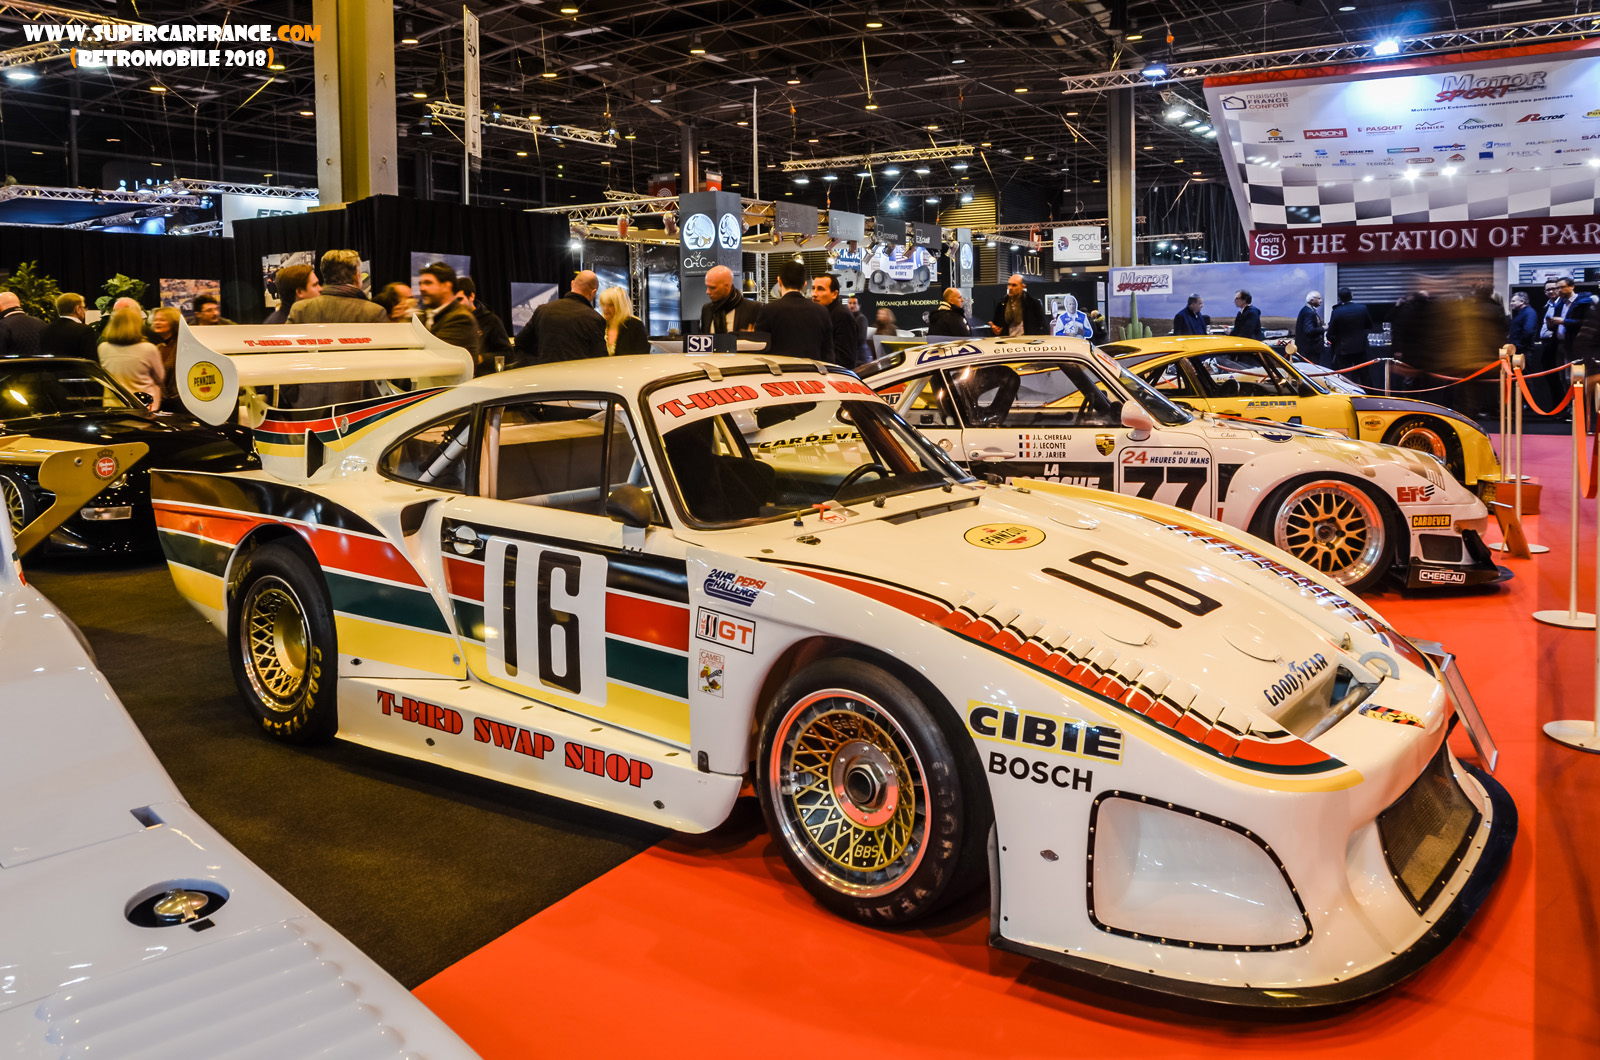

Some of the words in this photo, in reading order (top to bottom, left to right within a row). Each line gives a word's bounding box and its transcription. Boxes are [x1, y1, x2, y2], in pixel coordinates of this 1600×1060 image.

[1441, 70, 1547, 93] MOTOR
[1246, 92, 1288, 100] maisons
[1435, 84, 1512, 103] SPORT
[1249, 102, 1289, 110] CONFORT
[1458, 122, 1503, 131] Champeau
[1306, 130, 1344, 138] RABONI
[1071, 232, 1096, 243] sport
[1293, 233, 1348, 255] THE
[1358, 227, 1478, 254] STATION
[1488, 225, 1529, 248] OF
[1261, 244, 1279, 257] 66
[1016, 255, 1042, 276] PAUL
[1120, 271, 1169, 285] MOTOR
[1117, 281, 1153, 293] SPORT
[243, 339, 293, 347] T-BIRD
[296, 338, 334, 346] SWAP
[338, 337, 372, 345] SHOP
[689, 335, 712, 352] SP
[994, 345, 1067, 355] electropoli
[194, 374, 216, 387] PENNZOIL
[657, 384, 760, 419] T-BIRD
[760, 380, 826, 398] SWAP
[1044, 433, 1072, 441] CHEREAU
[1039, 442, 1066, 450] LECONTE
[1032, 451, 1044, 459] J.P.
[1045, 451, 1067, 459] JARIER
[1122, 450, 1148, 464] 24
[1150, 456, 1177, 465] HEURES
[1179, 456, 1188, 465] DU
[1190, 456, 1210, 465] MANS
[1043, 463, 1059, 476] LA
[1124, 466, 1207, 511] 77
[1413, 515, 1450, 527] CARDEVER
[980, 526, 1028, 546] PENNZOIL
[734, 575, 767, 590] PEPSI
[1421, 571, 1464, 582] CHEREAU
[705, 578, 760, 600] CHALLENGE
[1041, 550, 1223, 629] 16
[503, 544, 582, 695] 16
[718, 620, 753, 645] GT
[700, 651, 722, 663] CAMEL
[1263, 652, 1329, 707] GOODYEAR
[377, 689, 464, 735] T-BIRD
[474, 716, 555, 760] SWAP
[564, 741, 653, 788] SHOP
[988, 751, 1093, 793] BOSCH
[854, 844, 879, 859] BBS
